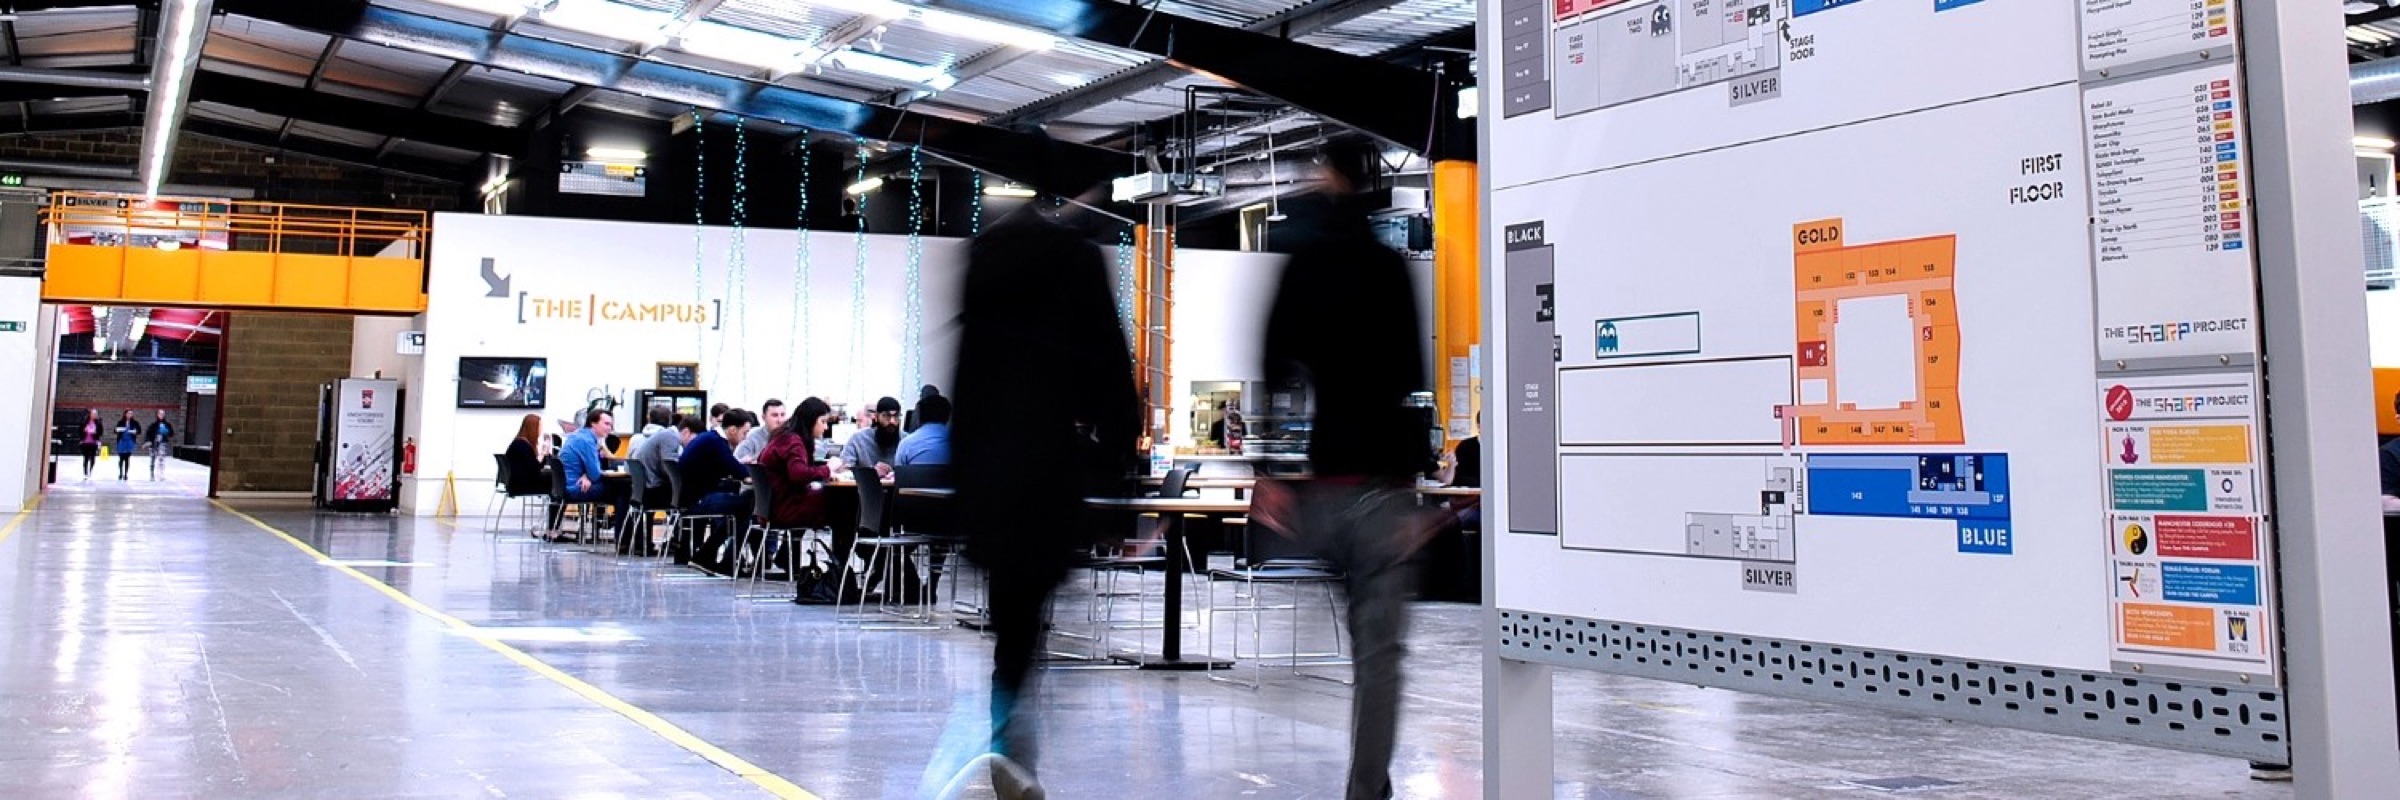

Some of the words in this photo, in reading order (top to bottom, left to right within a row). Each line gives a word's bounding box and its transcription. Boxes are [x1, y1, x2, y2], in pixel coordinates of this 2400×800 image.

[1790, 35, 1814, 48] STAGE
[1790, 48, 1815, 61] DOOR
[1732, 78, 1777, 99] SILVER
[2021, 153, 2062, 175] FIRST
[2010, 181, 2063, 205] FLOOR
[1507, 226, 1541, 244] BLACK
[1798, 226, 1839, 245] GOLD
[533, 298, 582, 318] THE
[601, 301, 706, 324] CAMPUS
[2104, 327, 2124, 338] THE
[2193, 318, 2247, 333] PROJECT
[2135, 398, 2151, 406] THE
[2206, 394, 2249, 406] PROJECT
[1962, 527, 2007, 546] BLUE
[1746, 569, 1793, 587] SILVER
